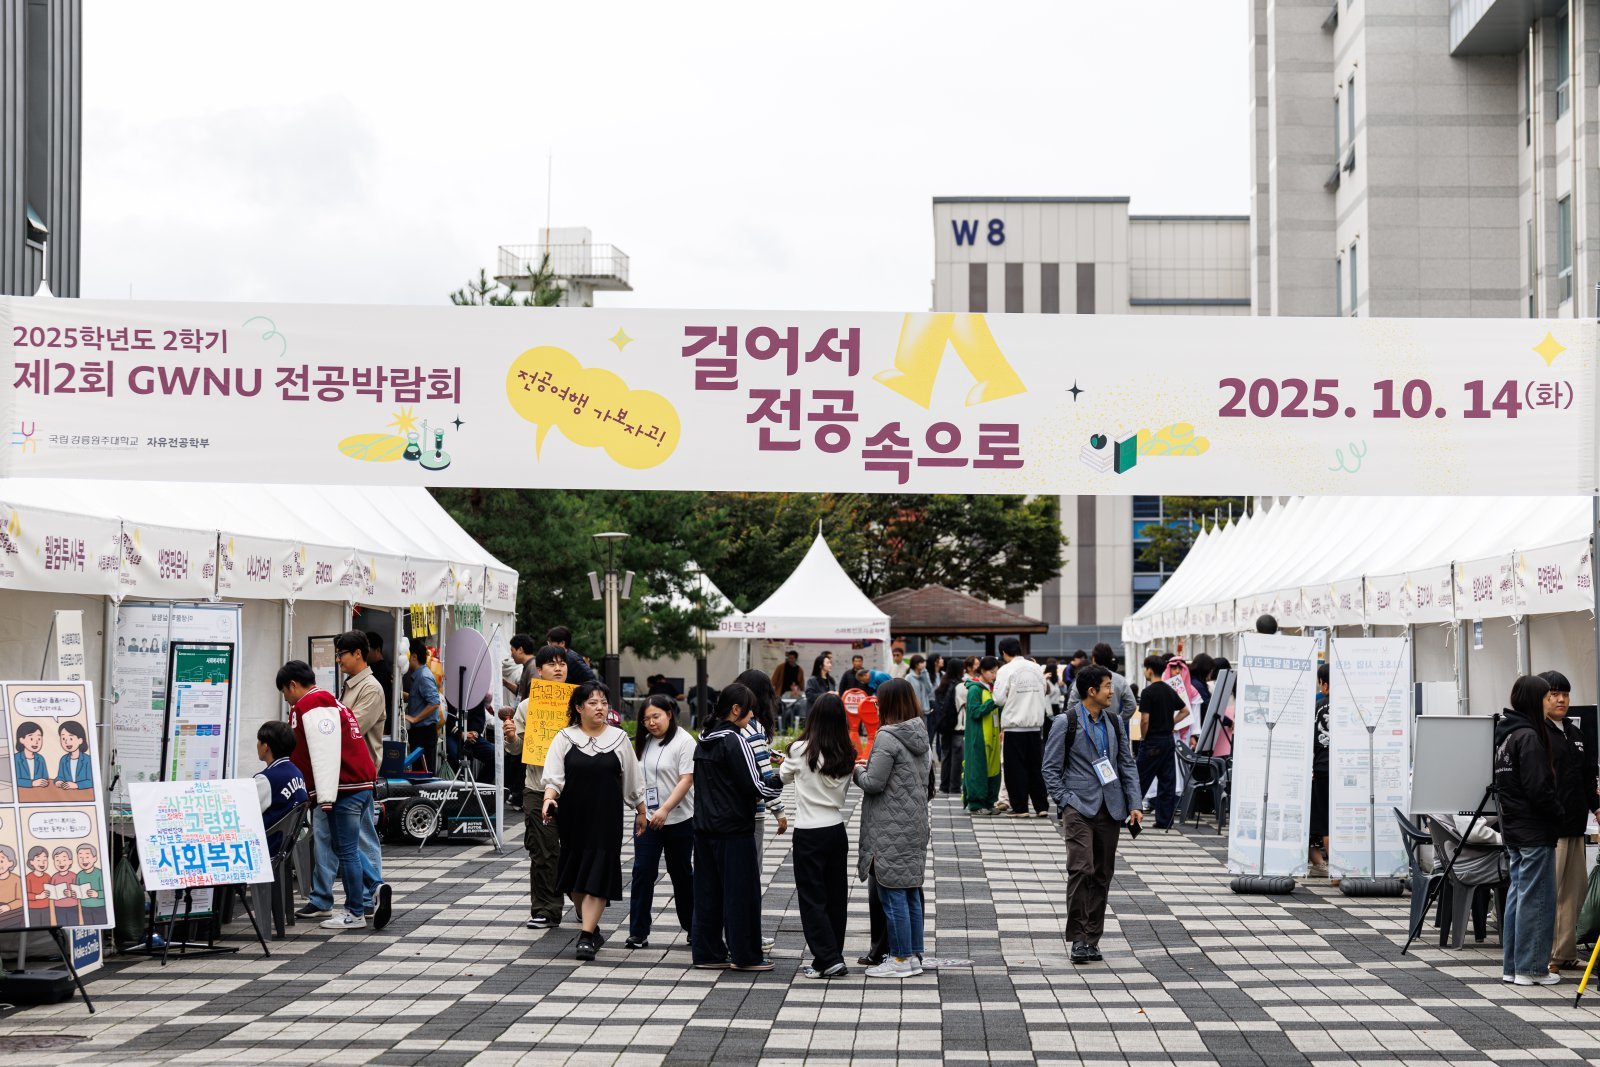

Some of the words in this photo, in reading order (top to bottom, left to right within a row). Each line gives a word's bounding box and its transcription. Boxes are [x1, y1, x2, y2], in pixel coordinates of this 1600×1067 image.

[13, 326, 156, 352] 2025학년도
[162, 327, 228, 354] 2학기
[681, 325, 861, 391] 걸어서
[12, 359, 115, 398] 제2회
[128, 365, 262, 398] GWNU
[274, 364, 463, 404] 전공박람회
[517, 370, 590, 415] 전공여행
[593, 407, 667, 448] 가보자고!
[1218, 377, 1357, 419] 2025.
[1372, 378, 1448, 419] 10.
[1462, 379, 1574, 419] 14(화)
[49, 434, 69, 445] 국립
[147, 437, 210, 449] 자유전공학부
[746, 388, 859, 454] 전공
[861, 421, 1025, 485] 속으로
[716, 621, 767, 633] 마트건설
[167, 793, 222, 813] 사각지대
[418, 789, 459, 801] makita
[184, 810, 241, 835] 고령화
[149, 834, 183, 846] 주간보호
[158, 841, 254, 875] 사회복지
[178, 874, 214, 888] 자원봉사
